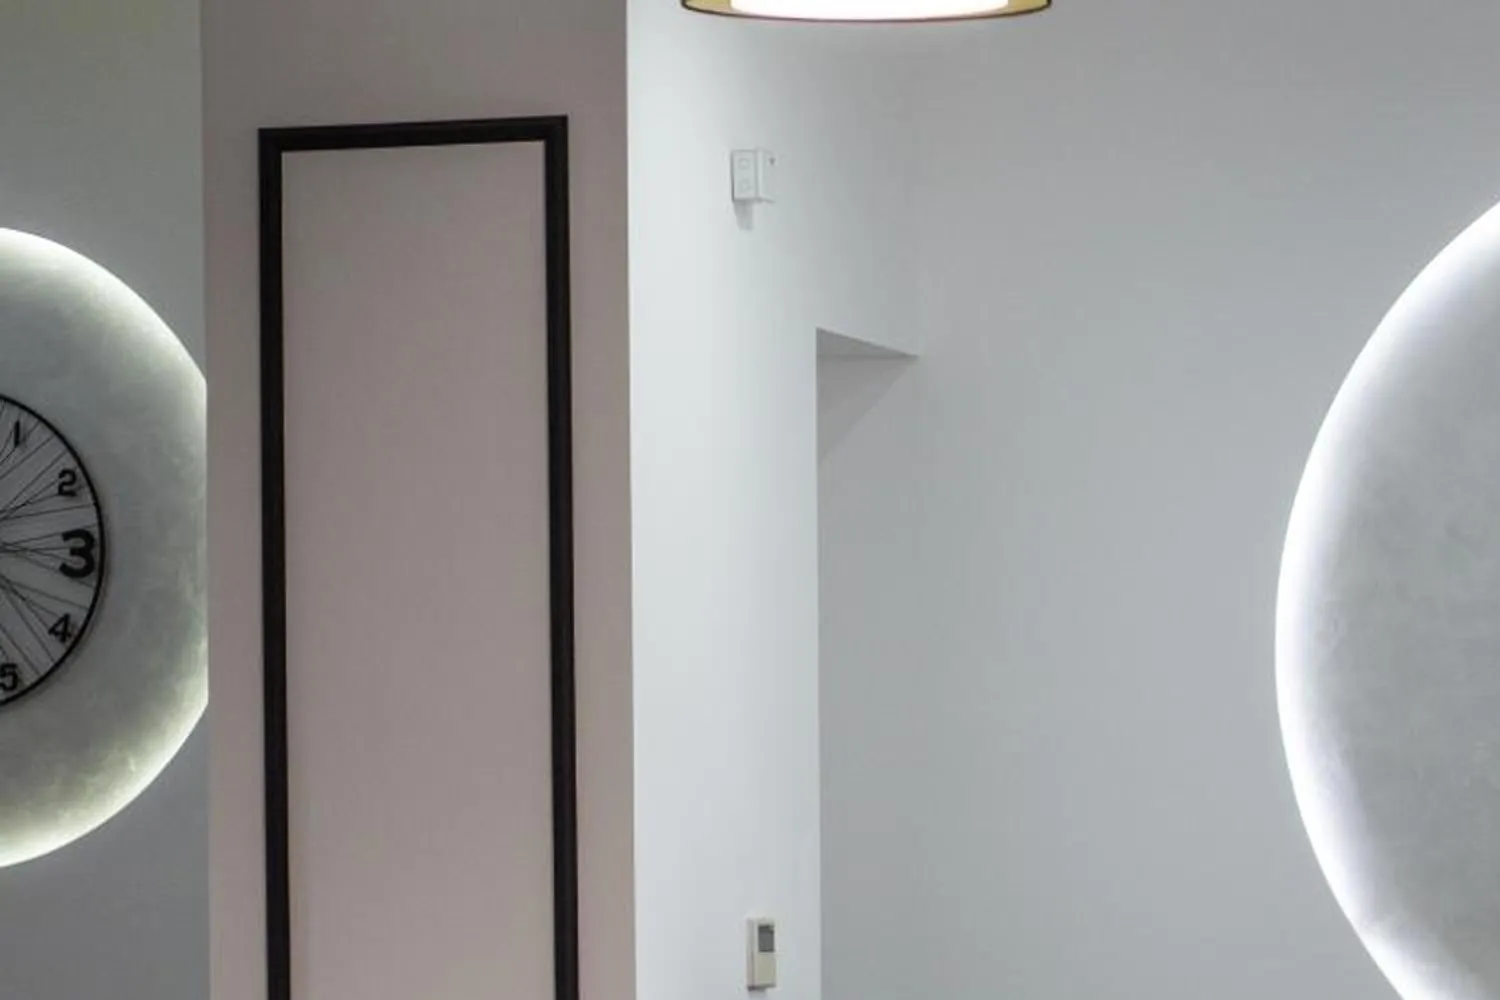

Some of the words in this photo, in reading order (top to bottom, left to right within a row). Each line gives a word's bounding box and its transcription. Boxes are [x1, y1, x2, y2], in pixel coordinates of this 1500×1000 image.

[58, 469, 77, 497] 2
[59, 529, 95, 579] 3
[49, 613, 72, 643] 4
[0, 663, 19, 692] 5
